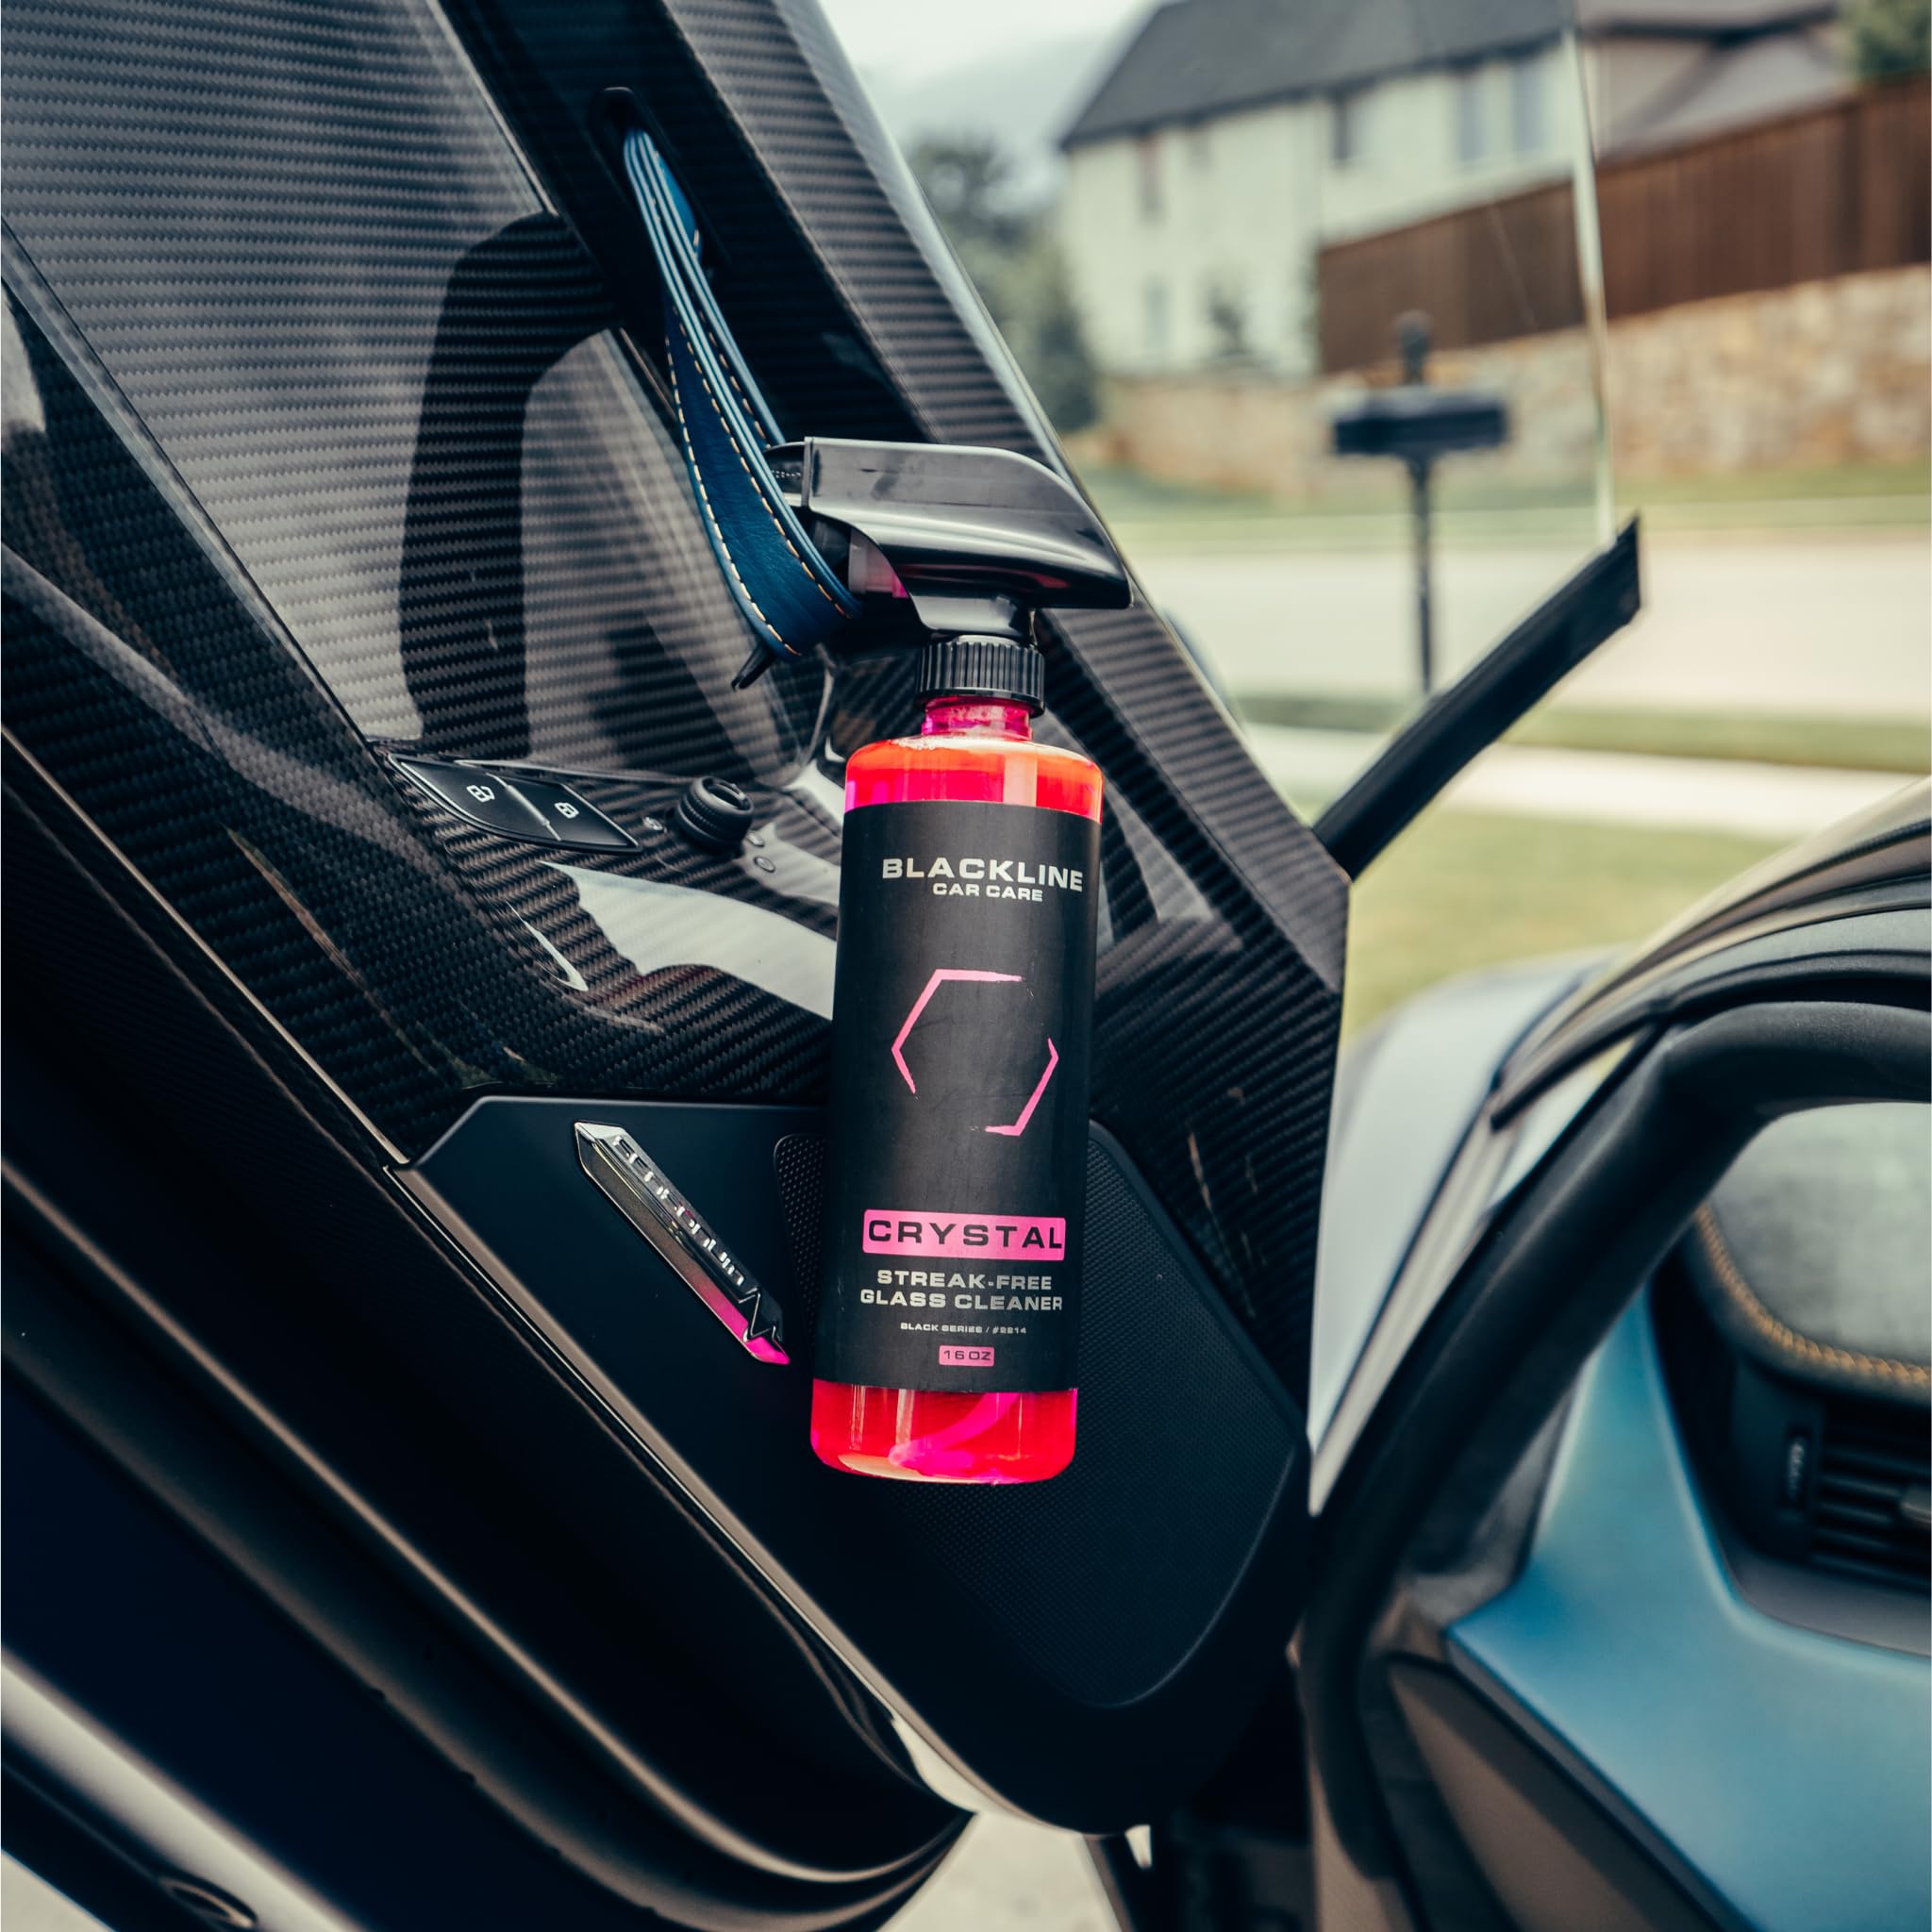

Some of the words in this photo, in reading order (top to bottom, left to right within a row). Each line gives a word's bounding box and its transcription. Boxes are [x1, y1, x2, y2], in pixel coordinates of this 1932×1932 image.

[882, 857, 1084, 892] BLACKLINE
[932, 882, 980, 897] CAR
[985, 885, 1043, 902] CARE
[868, 1219, 1062, 1250] CRYSTAL
[877, 1269, 1052, 1291] STREAK-FREE
[860, 1289, 947, 1309] GLASS
[954, 1295, 1063, 1311] CLEANER
[900, 1322, 940, 1332] BLACK
[941, 1324, 983, 1334] SERIES
[942, 1349, 965, 1361] 16
[968, 1350, 991, 1361] OZ
